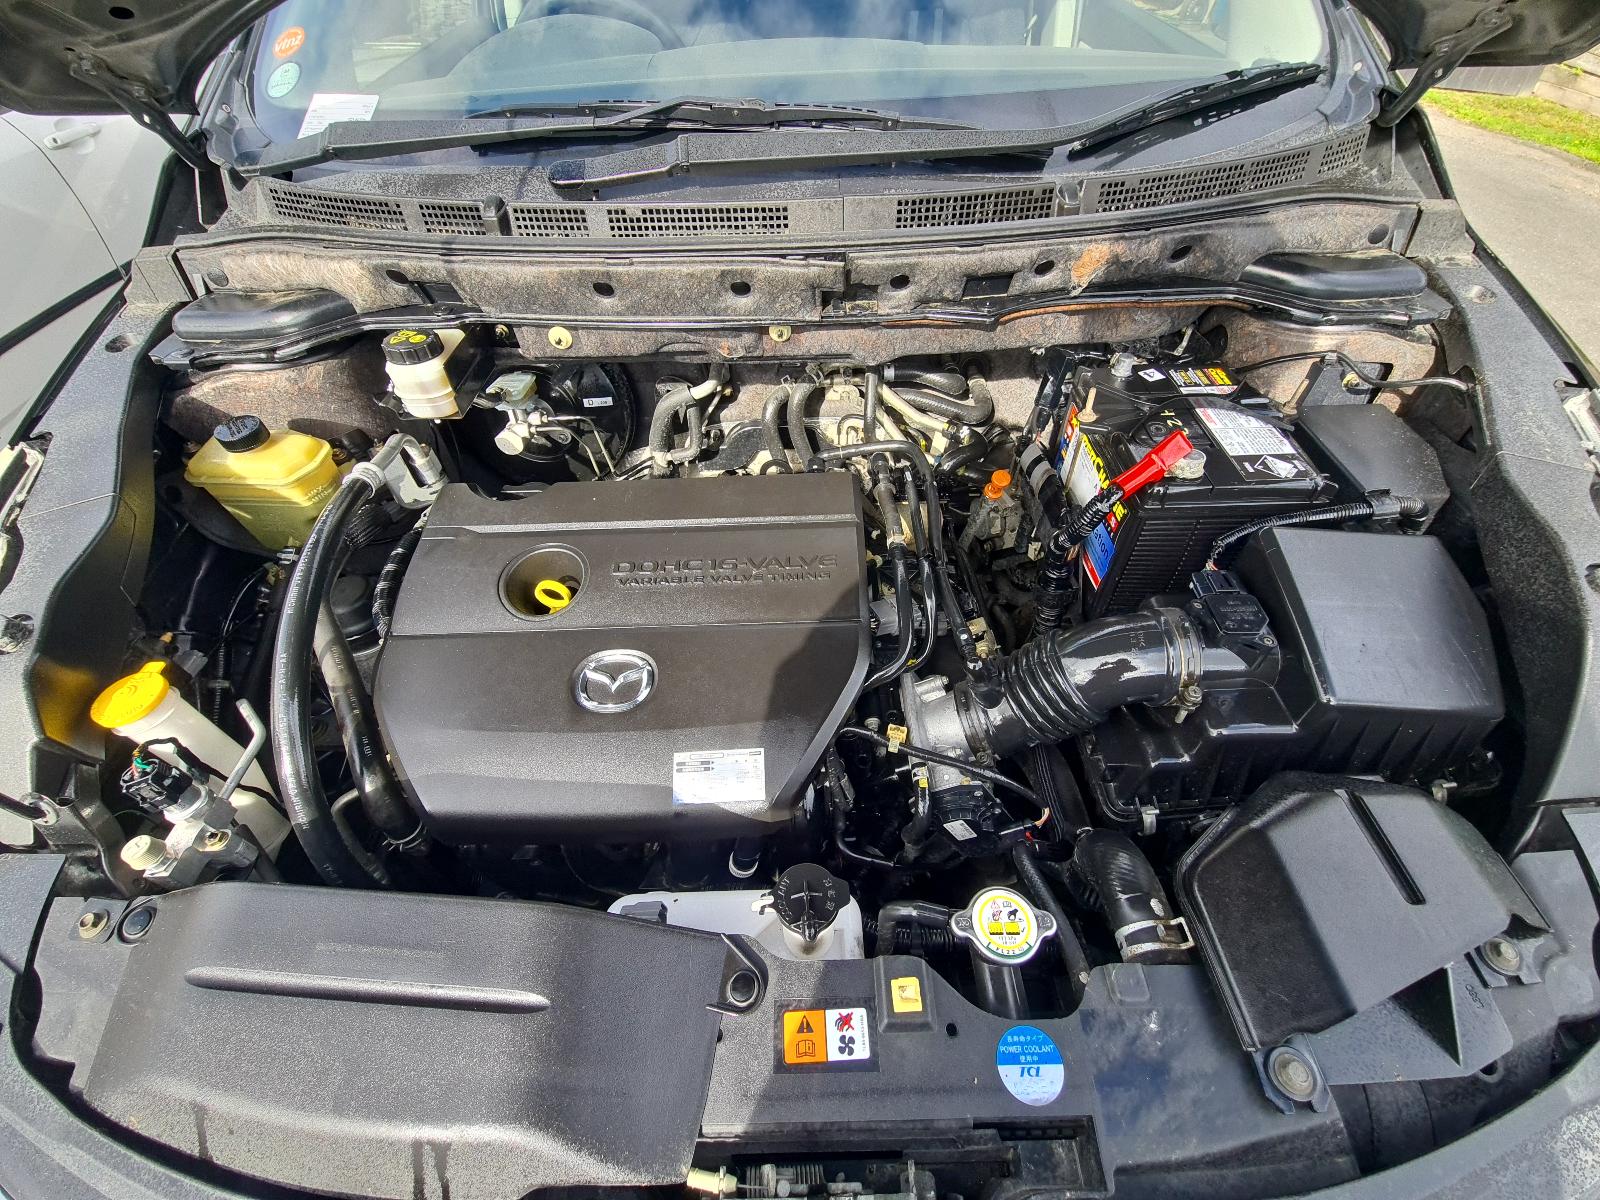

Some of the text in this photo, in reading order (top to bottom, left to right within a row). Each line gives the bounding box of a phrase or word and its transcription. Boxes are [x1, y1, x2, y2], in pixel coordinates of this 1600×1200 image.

[1093, 526, 1110, 561] ation
[613, 559, 703, 575] DOHC
[617, 570, 832, 587] VARIABLE VALVE TIMING
[1000, 1044, 1054, 1053] POWER COOLANT
